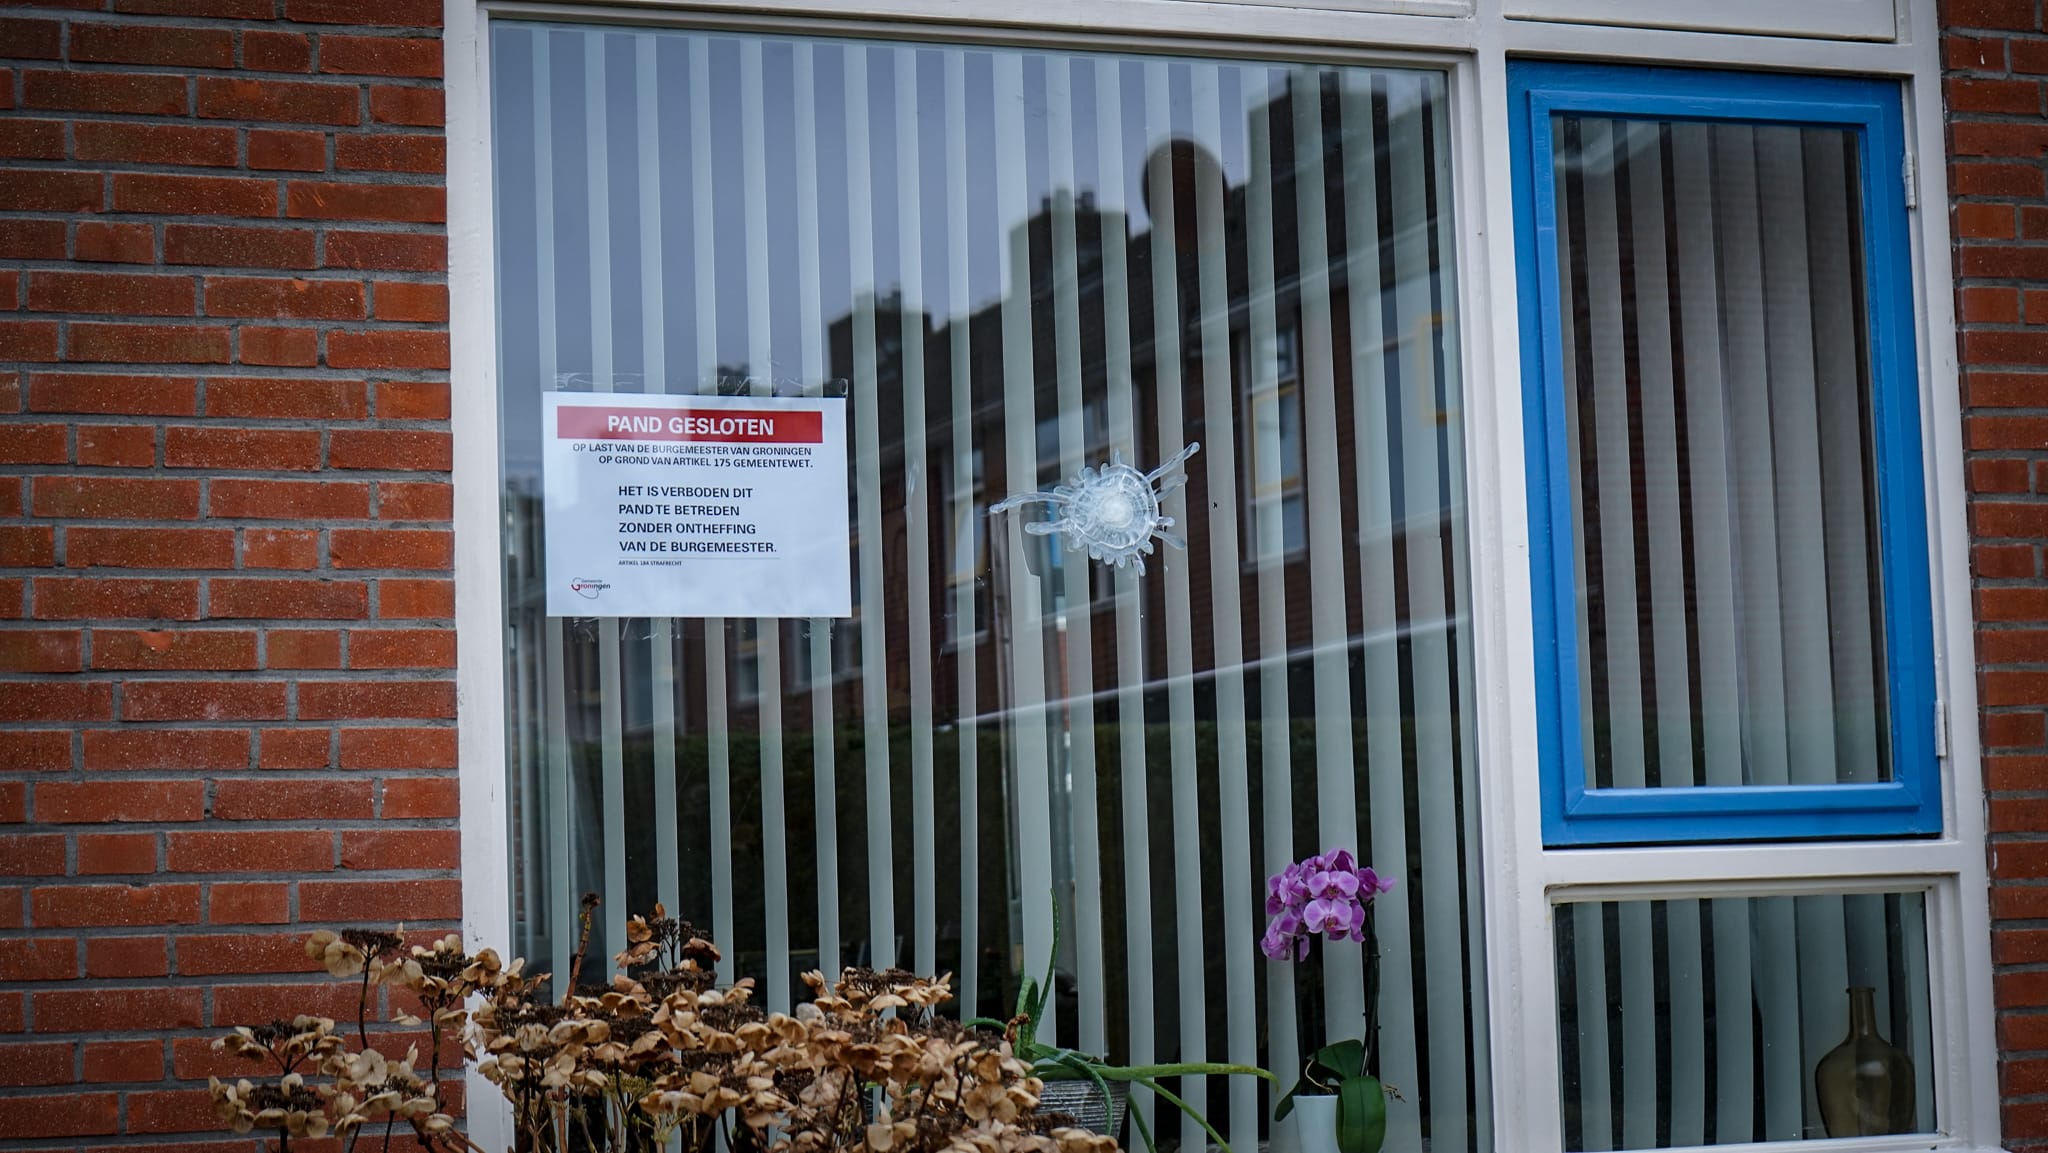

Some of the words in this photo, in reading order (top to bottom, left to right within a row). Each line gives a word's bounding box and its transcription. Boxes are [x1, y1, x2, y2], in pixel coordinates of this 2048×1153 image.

[608, 415, 662, 434] PAND
[668, 417, 774, 436] GESLOTEN
[572, 443, 586, 452] OP
[589, 443, 613, 453] LAST
[615, 443, 635, 453] VAN
[637, 444, 650, 453] DE
[652, 445, 729, 455] BURGEMEESTER
[730, 446, 750, 455] VAN
[752, 446, 812, 456] GRONINGEN
[598, 455, 613, 464] OP
[615, 455, 650, 465] GROND
[651, 456, 671, 466] VAN
[672, 457, 712, 466] ARTIKEL
[714, 458, 731, 467] 175
[733, 458, 813, 468] GEMEENTEWET.
[618, 486, 643, 496] HET
[647, 486, 659, 497] IS
[660, 486, 730, 498] VERBODEN
[733, 487, 753, 498] DIT
[618, 504, 654, 515] PAND
[656, 504, 670, 515] TE
[675, 505, 740, 516] BETREDEN
[618, 522, 672, 533] ZONDER
[675, 523, 756, 535] ONTHEFFING
[619, 541, 646, 552] VAN
[650, 541, 667, 552] DE
[671, 541, 777, 553] BURGEMEESTER.
[571, 583, 611, 591] Groningen
